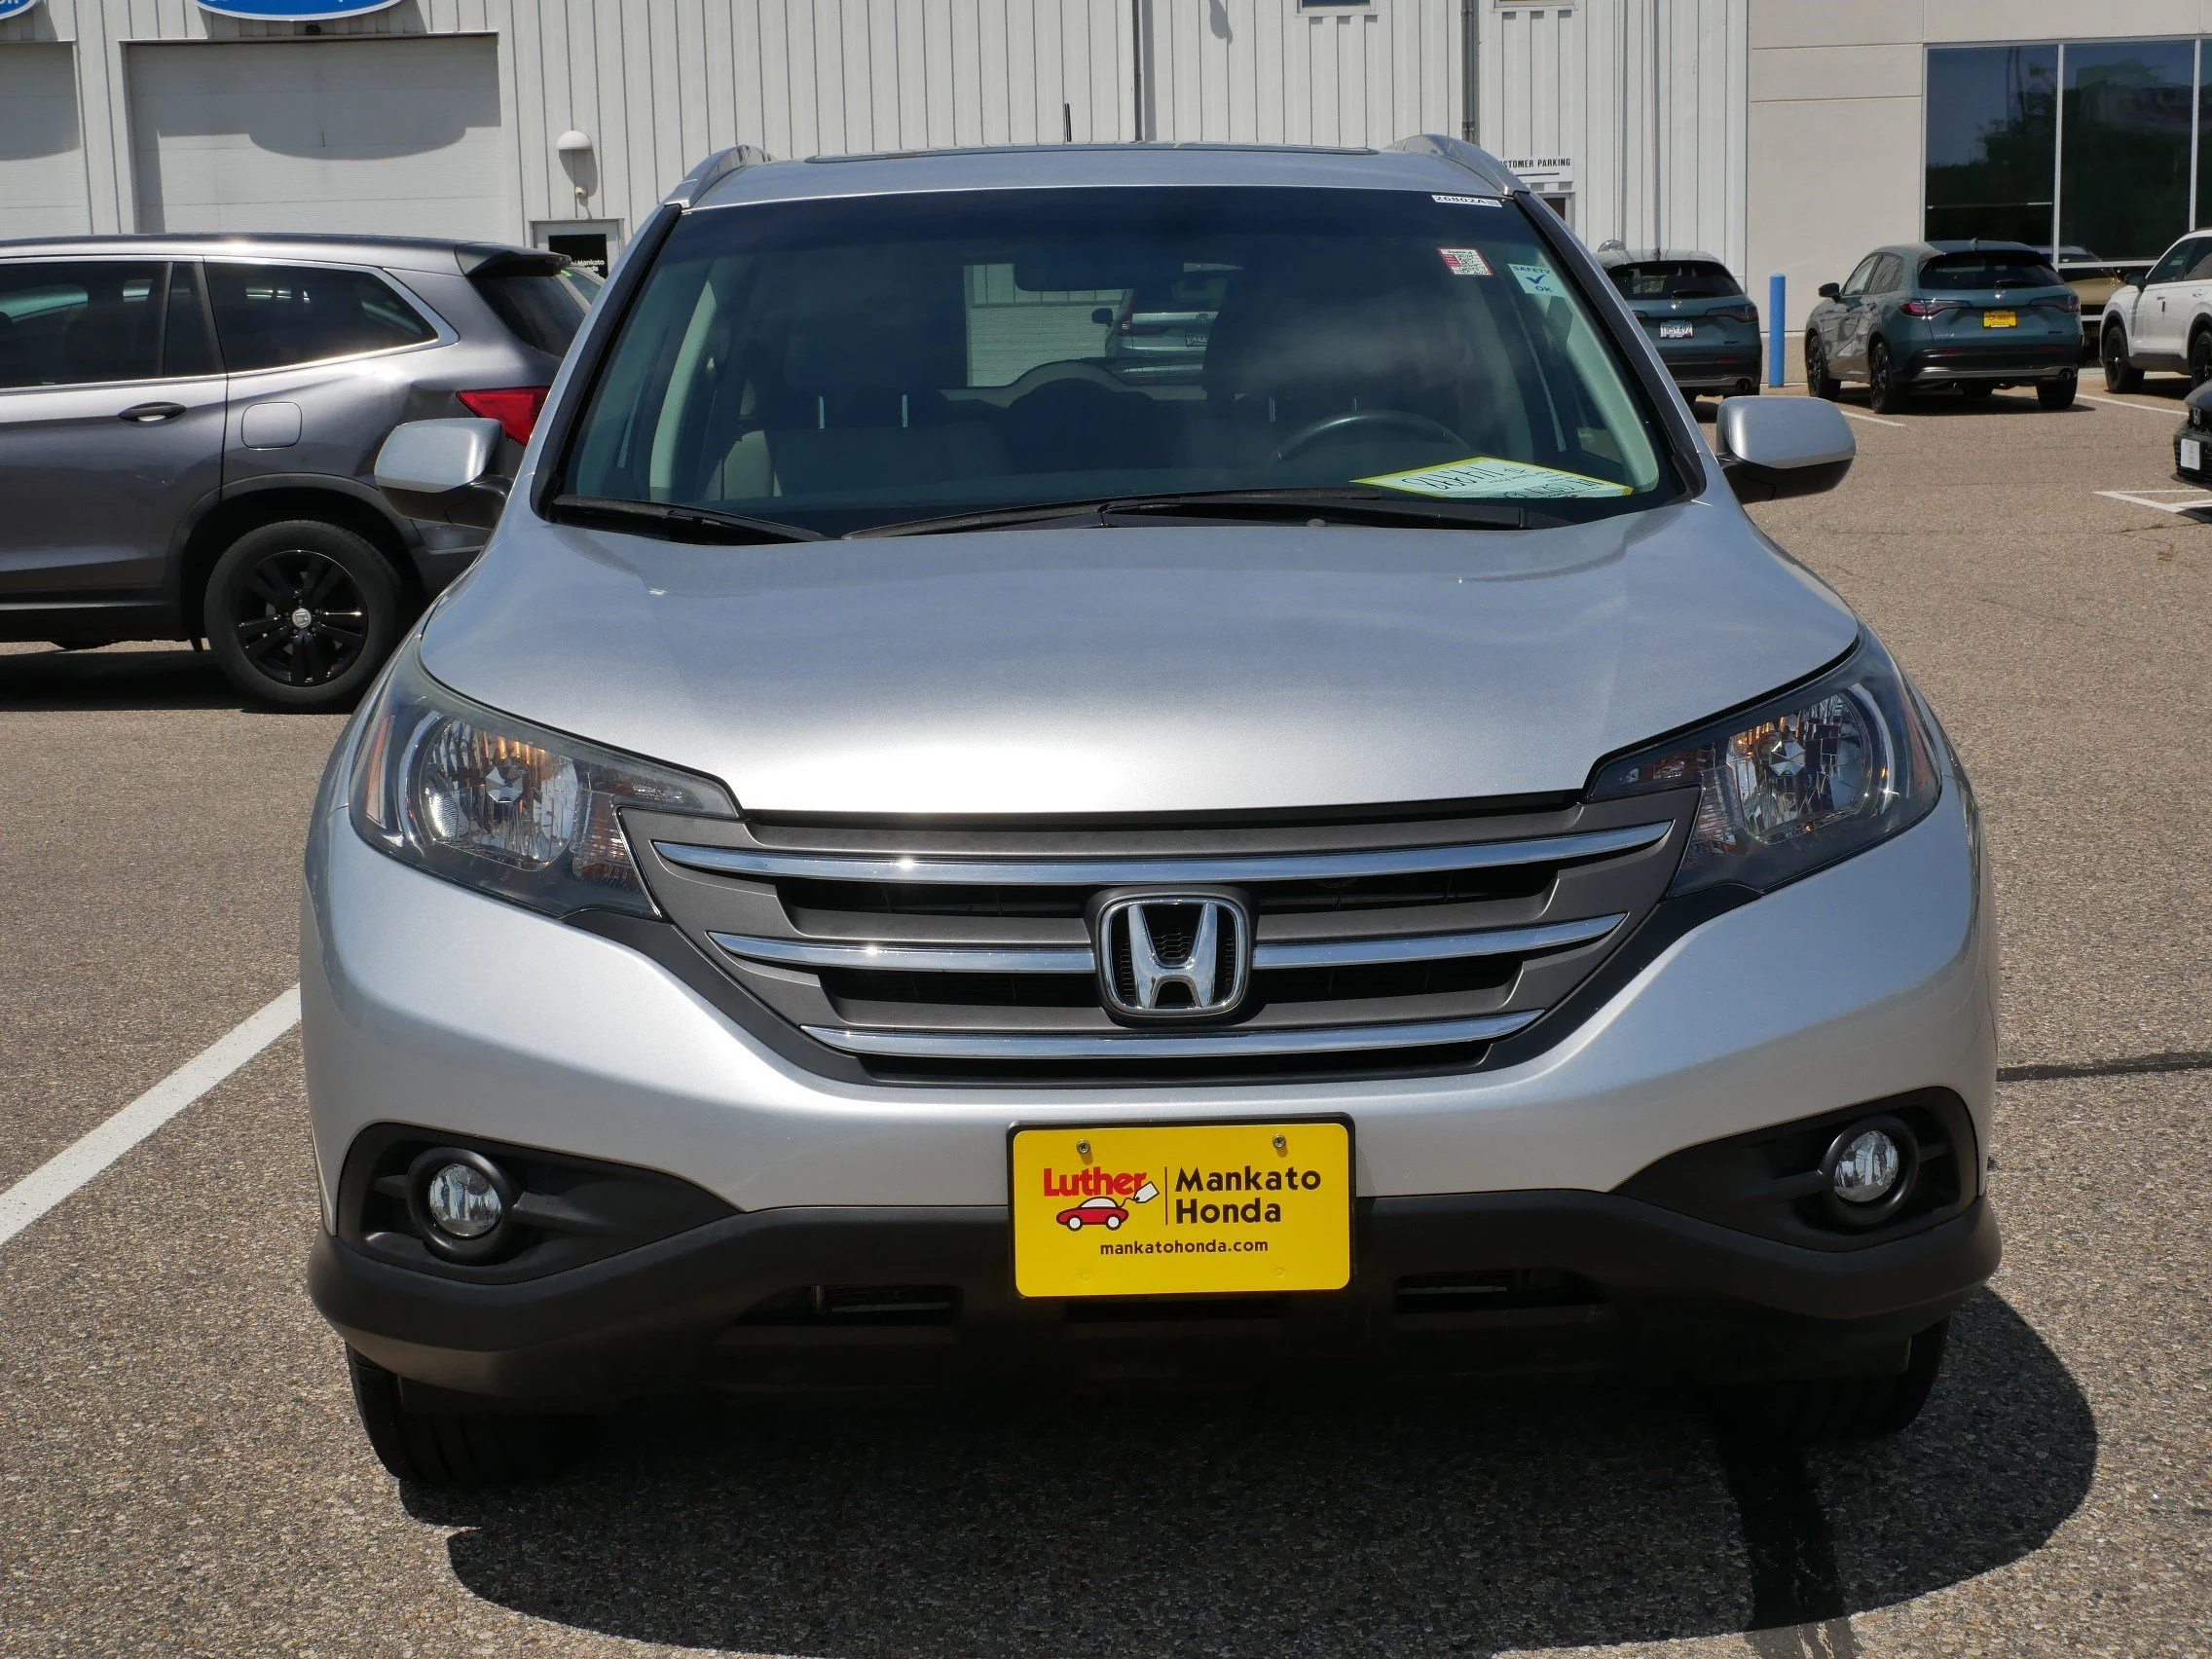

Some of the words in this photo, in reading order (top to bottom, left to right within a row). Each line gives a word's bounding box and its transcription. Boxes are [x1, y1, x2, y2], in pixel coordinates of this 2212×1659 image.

[1500, 160, 1534, 168] STOMER
[1538, 158, 1570, 167] PARKING
[1043, 1166, 1148, 1198] Luther
[1174, 1165, 1322, 1193] Mankato
[1175, 1198, 1282, 1225] Honda
[1100, 1238, 1270, 1256] mankatohonda.com
